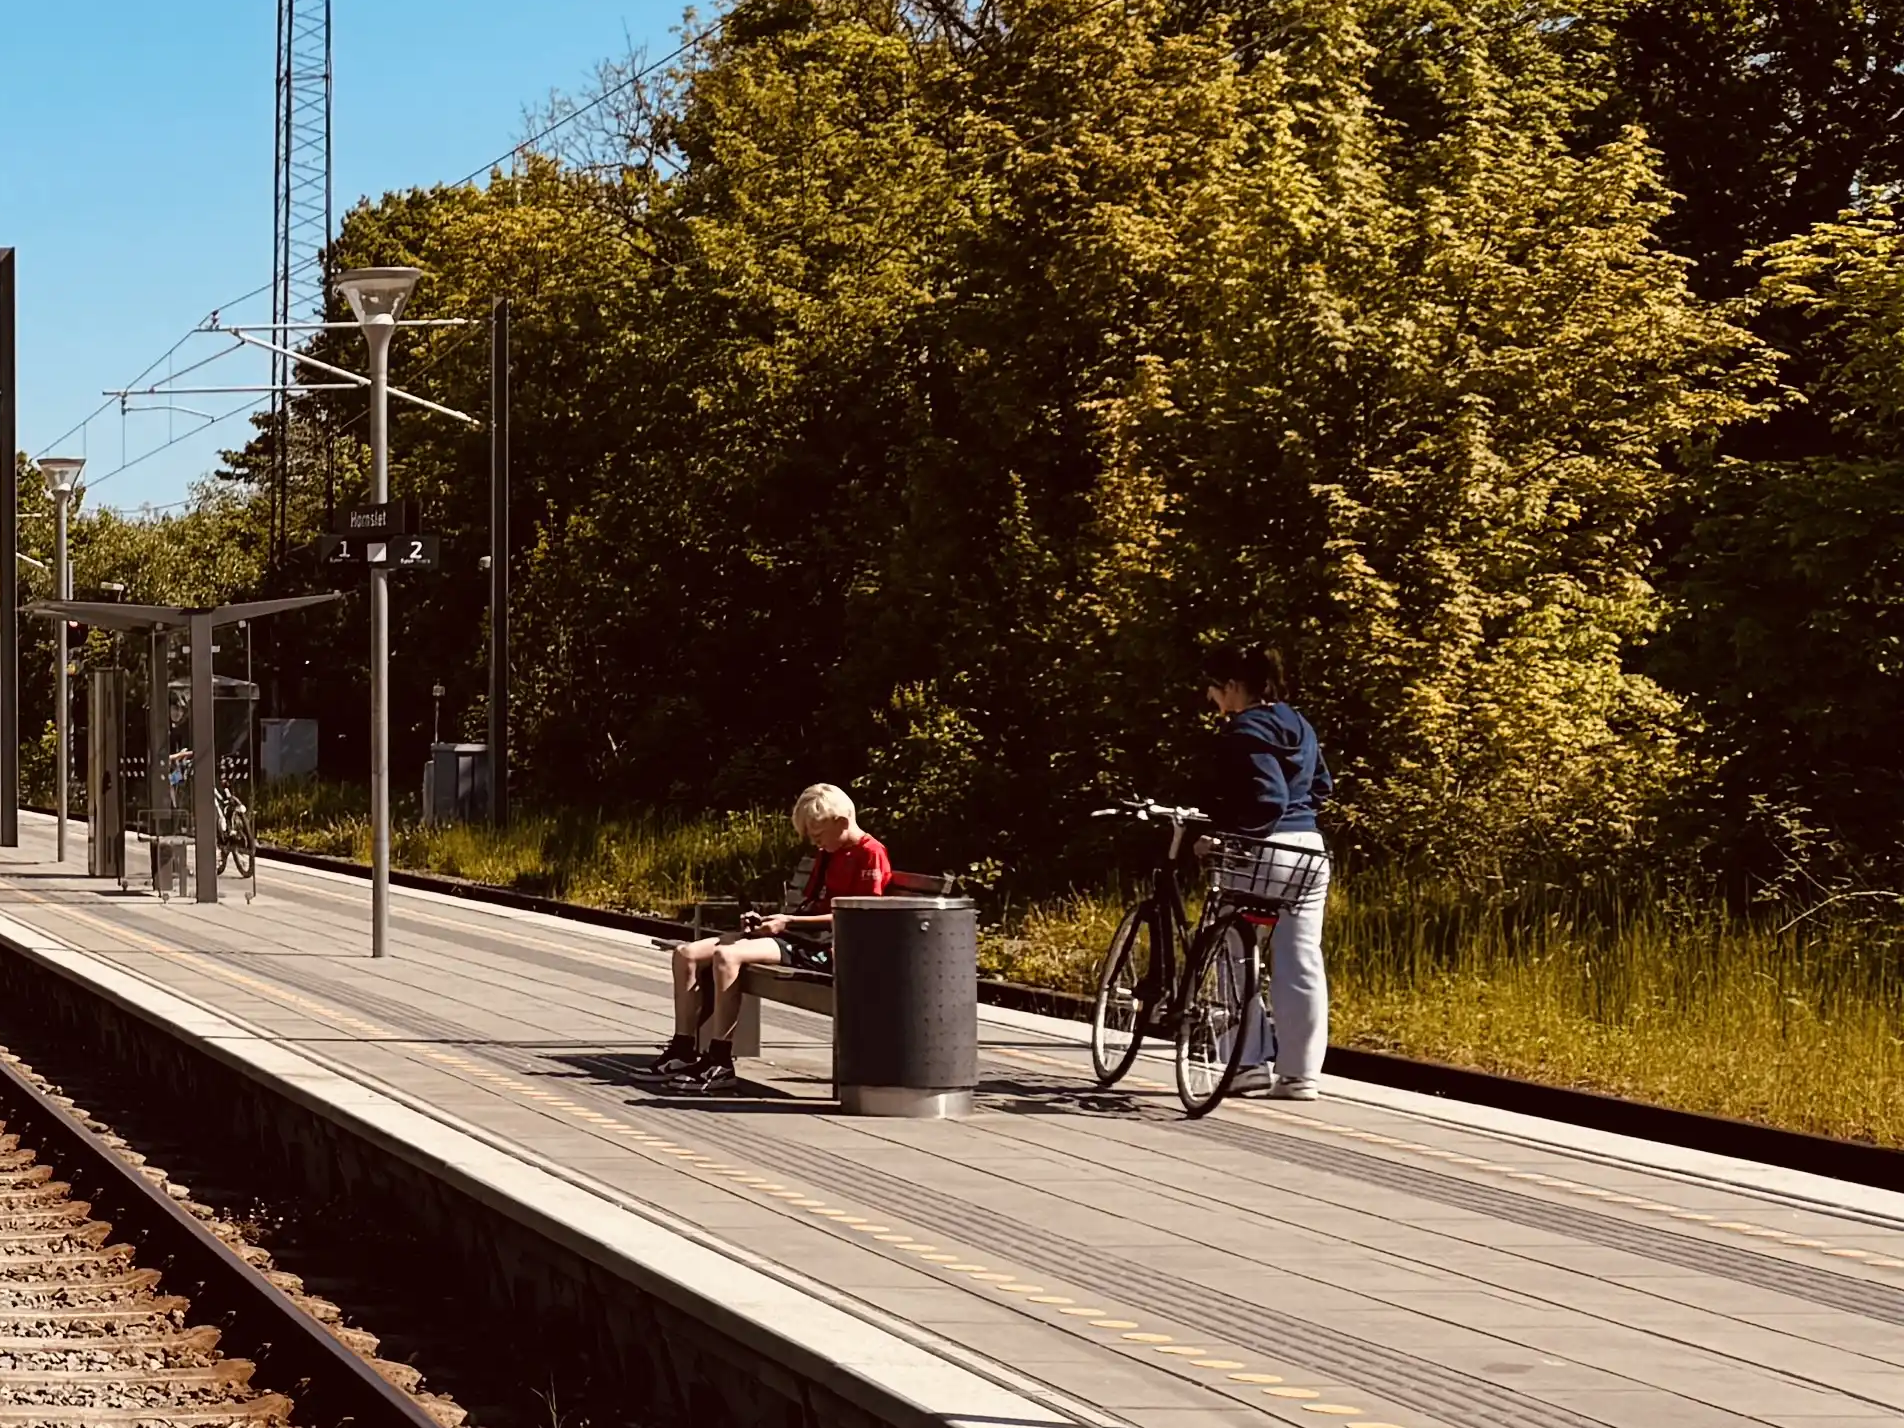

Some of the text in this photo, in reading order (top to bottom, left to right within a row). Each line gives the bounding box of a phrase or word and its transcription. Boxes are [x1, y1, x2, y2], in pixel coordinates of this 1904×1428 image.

[350, 511, 387, 528] Hornslet
[339, 540, 351, 558] 1
[409, 541, 423, 559] 2
